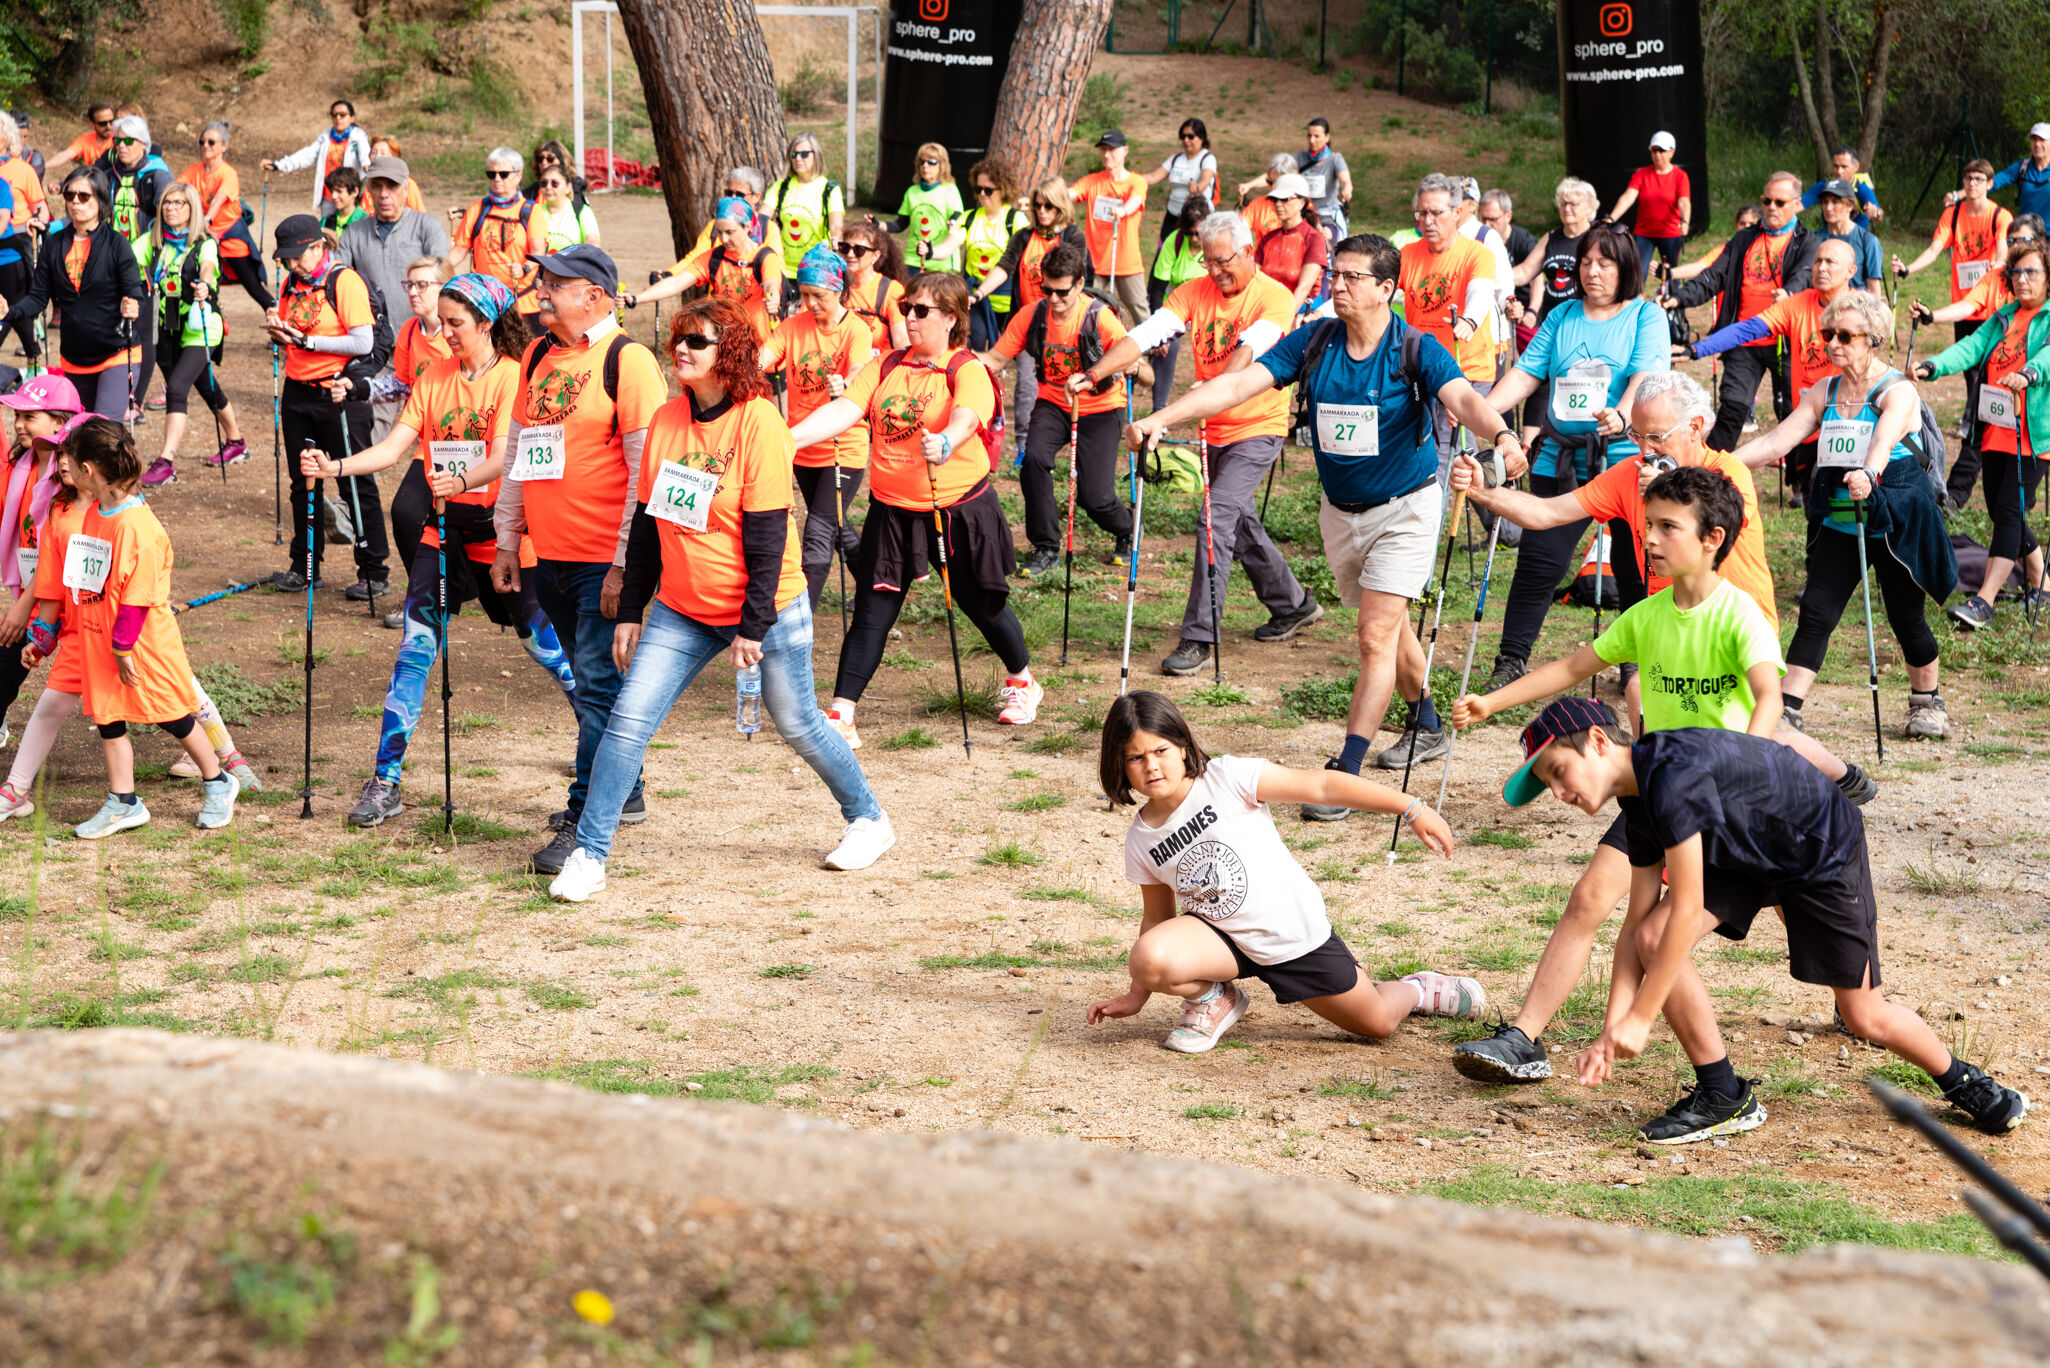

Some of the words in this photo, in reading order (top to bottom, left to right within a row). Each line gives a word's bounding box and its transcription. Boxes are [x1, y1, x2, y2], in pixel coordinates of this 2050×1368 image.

[896, 20, 976, 44] sphere_pro
[1574, 39, 1664, 60] sphere_pro
[1566, 65, 1684, 83] www.sphere-pro.com
[1569, 393, 1588, 408] 82
[1990, 402, 2004, 416] 69
[1319, 409, 1360, 417] XAMMARXADA
[521, 432, 552, 440] XAMMARXADA
[1335, 424, 1356, 440] 27
[1827, 437, 1856, 453] 100
[527, 446, 553, 465] 133
[448, 461, 467, 477] 93
[664, 467, 700, 483] XAMMARXADA
[666, 485, 697, 511] 124
[83, 556, 104, 577] 137
[1149, 804, 1218, 867] RAMONES
[1179, 842, 1216, 877] JOHNNY
[1220, 848, 1244, 875] JOEY
